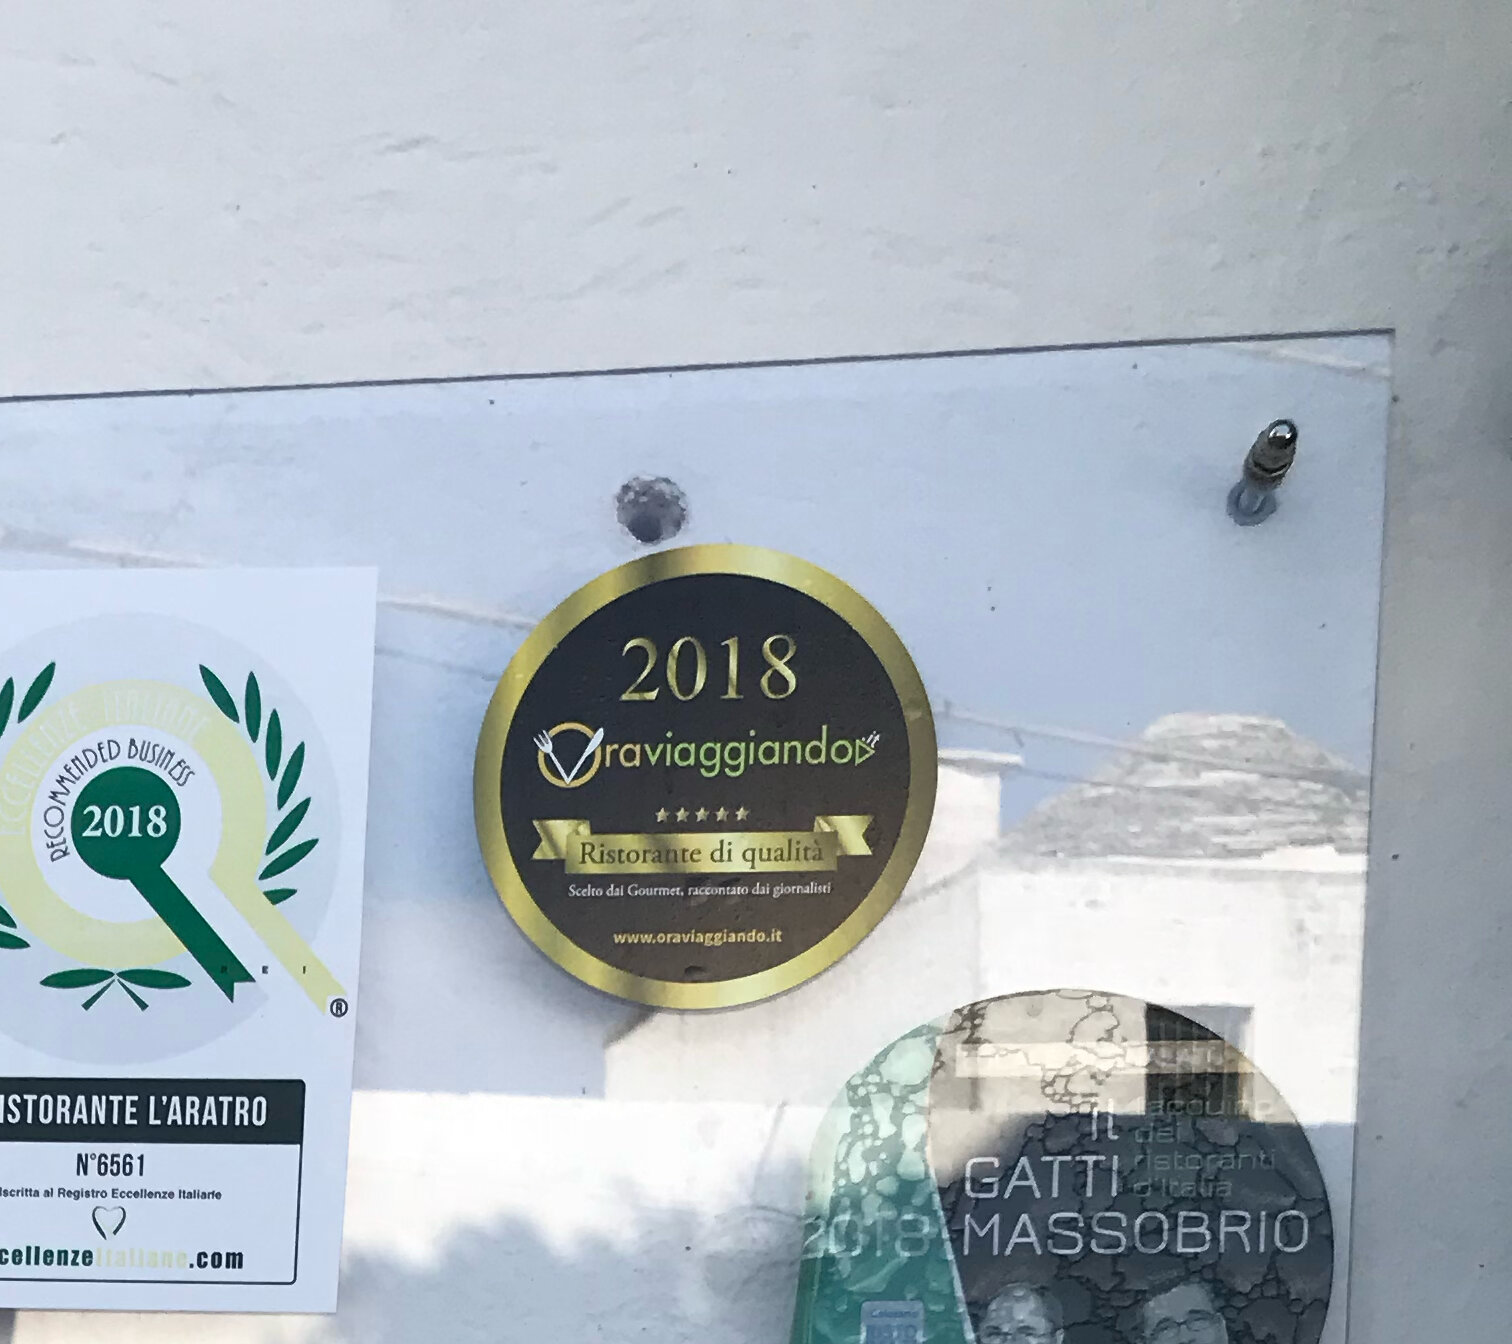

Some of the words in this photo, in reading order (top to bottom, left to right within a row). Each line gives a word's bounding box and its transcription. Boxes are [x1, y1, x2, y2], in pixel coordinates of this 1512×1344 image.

[619, 634, 798, 702] 2018
[43, 739, 121, 862] RECOMMENDED
[128, 738, 195, 787] BUSINESS
[81, 804, 168, 838] 2018
[578, 841, 701, 866] Ristorante
[710, 839, 735, 864] di
[741, 838, 825, 869] qualità
[568, 883, 604, 897] Scelto
[688, 883, 749, 897] raccontato
[773, 881, 832, 899] giornalisti
[613, 928, 783, 946] www.oraviaggiando.it
[148, 1095, 268, 1127] L'ARATRO
[76, 1152, 146, 1178] N°6561
[963, 1154, 1120, 1200] GATTI
[43, 1187, 54, 1199] al
[57, 1187, 108, 1201] Registro
[111, 1188, 175, 1200] Eccellenze
[801, 1212, 930, 1259] 2018
[962, 1210, 1310, 1256] MASSOBRIO
